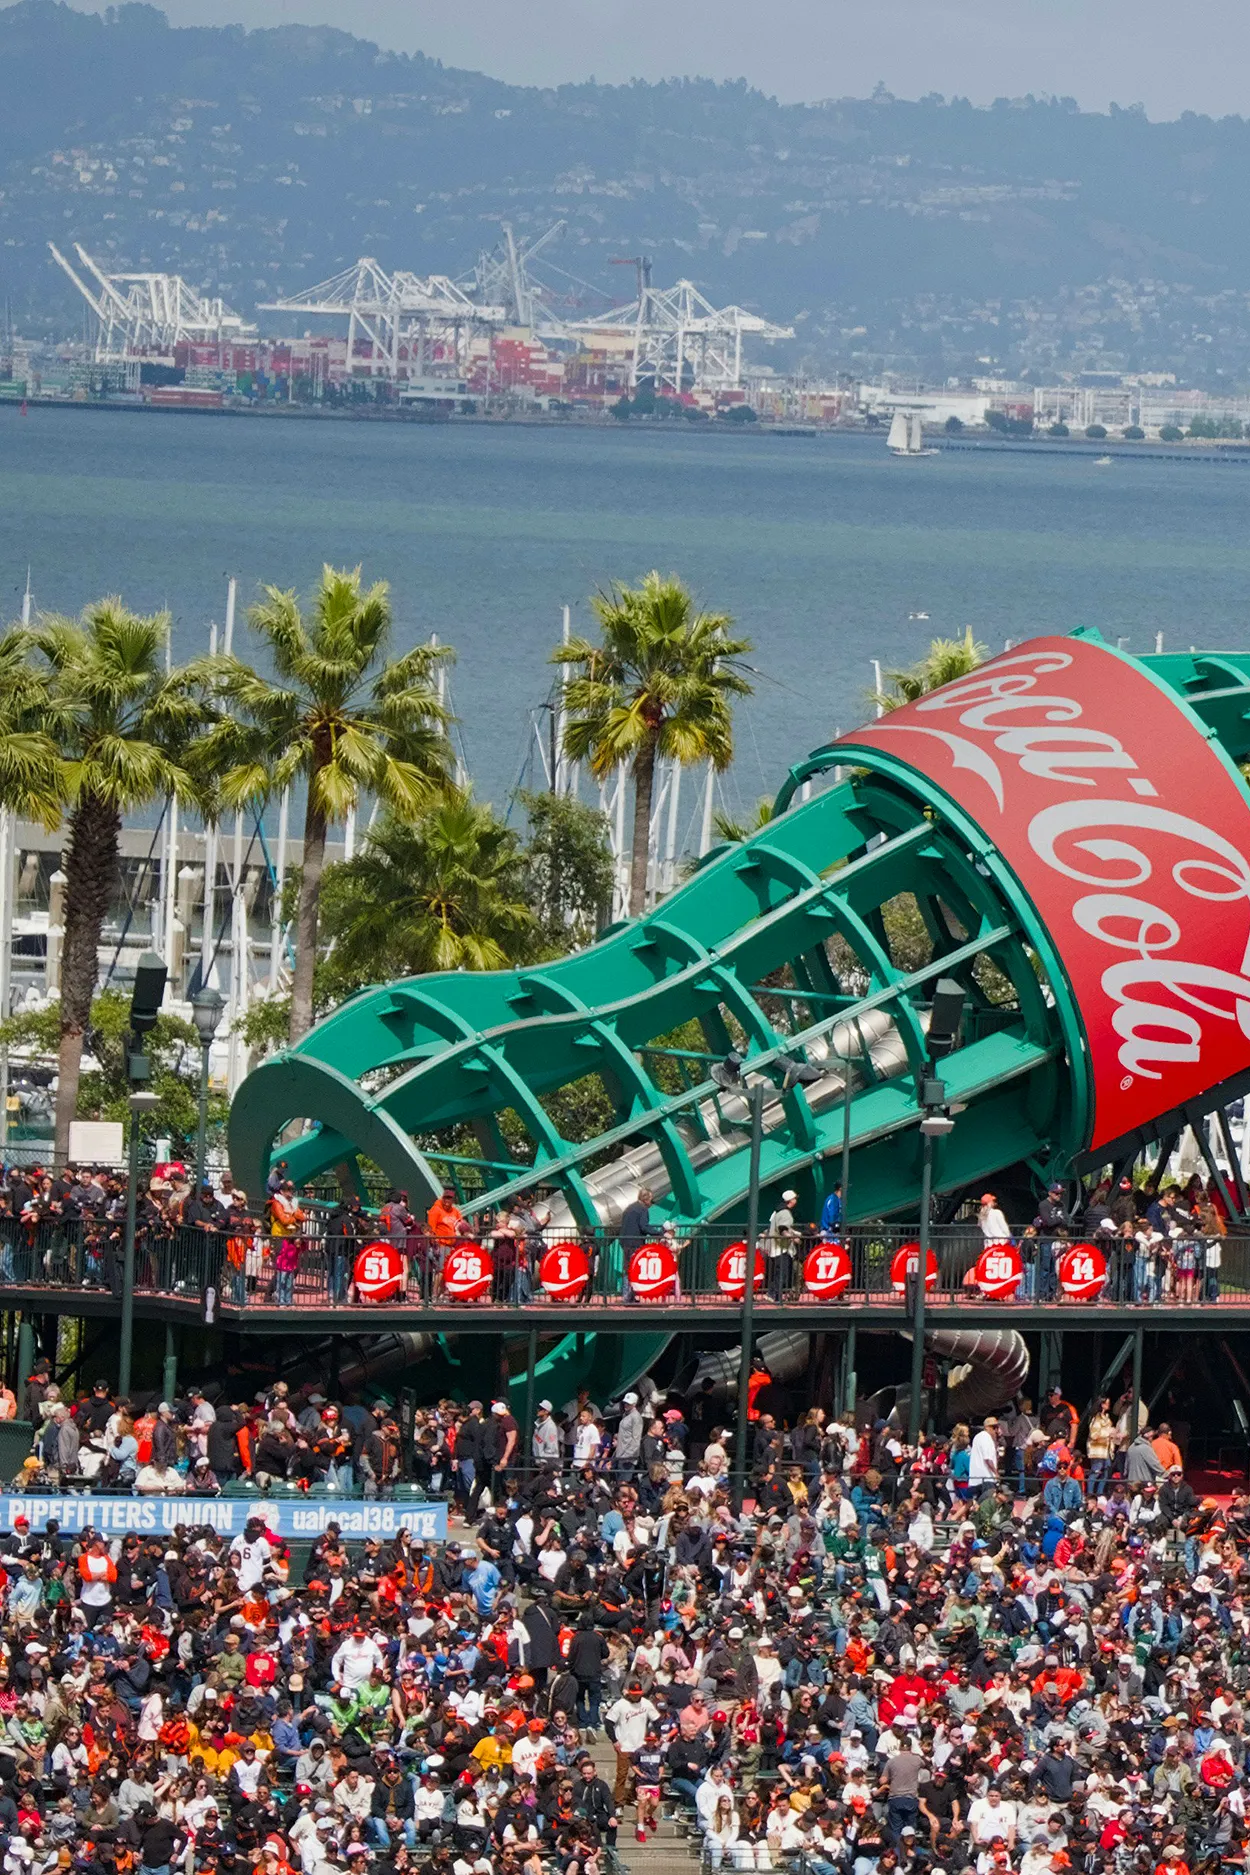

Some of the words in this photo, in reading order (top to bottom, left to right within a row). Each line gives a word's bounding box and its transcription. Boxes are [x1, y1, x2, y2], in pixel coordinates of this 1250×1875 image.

[364, 1257, 390, 1280] 51
[452, 1257, 482, 1280] 26
[558, 1257, 570, 1280] 1
[638, 1257, 662, 1280] 10
[816, 1256, 840, 1280] 17
[985, 1257, 1012, 1280] 50
[1071, 1257, 1095, 1280] 14
[9, 1500, 156, 1529] PIPEFITTERS
[162, 1502, 233, 1530] UNION
[292, 1506, 437, 1538] ualocal38.org
